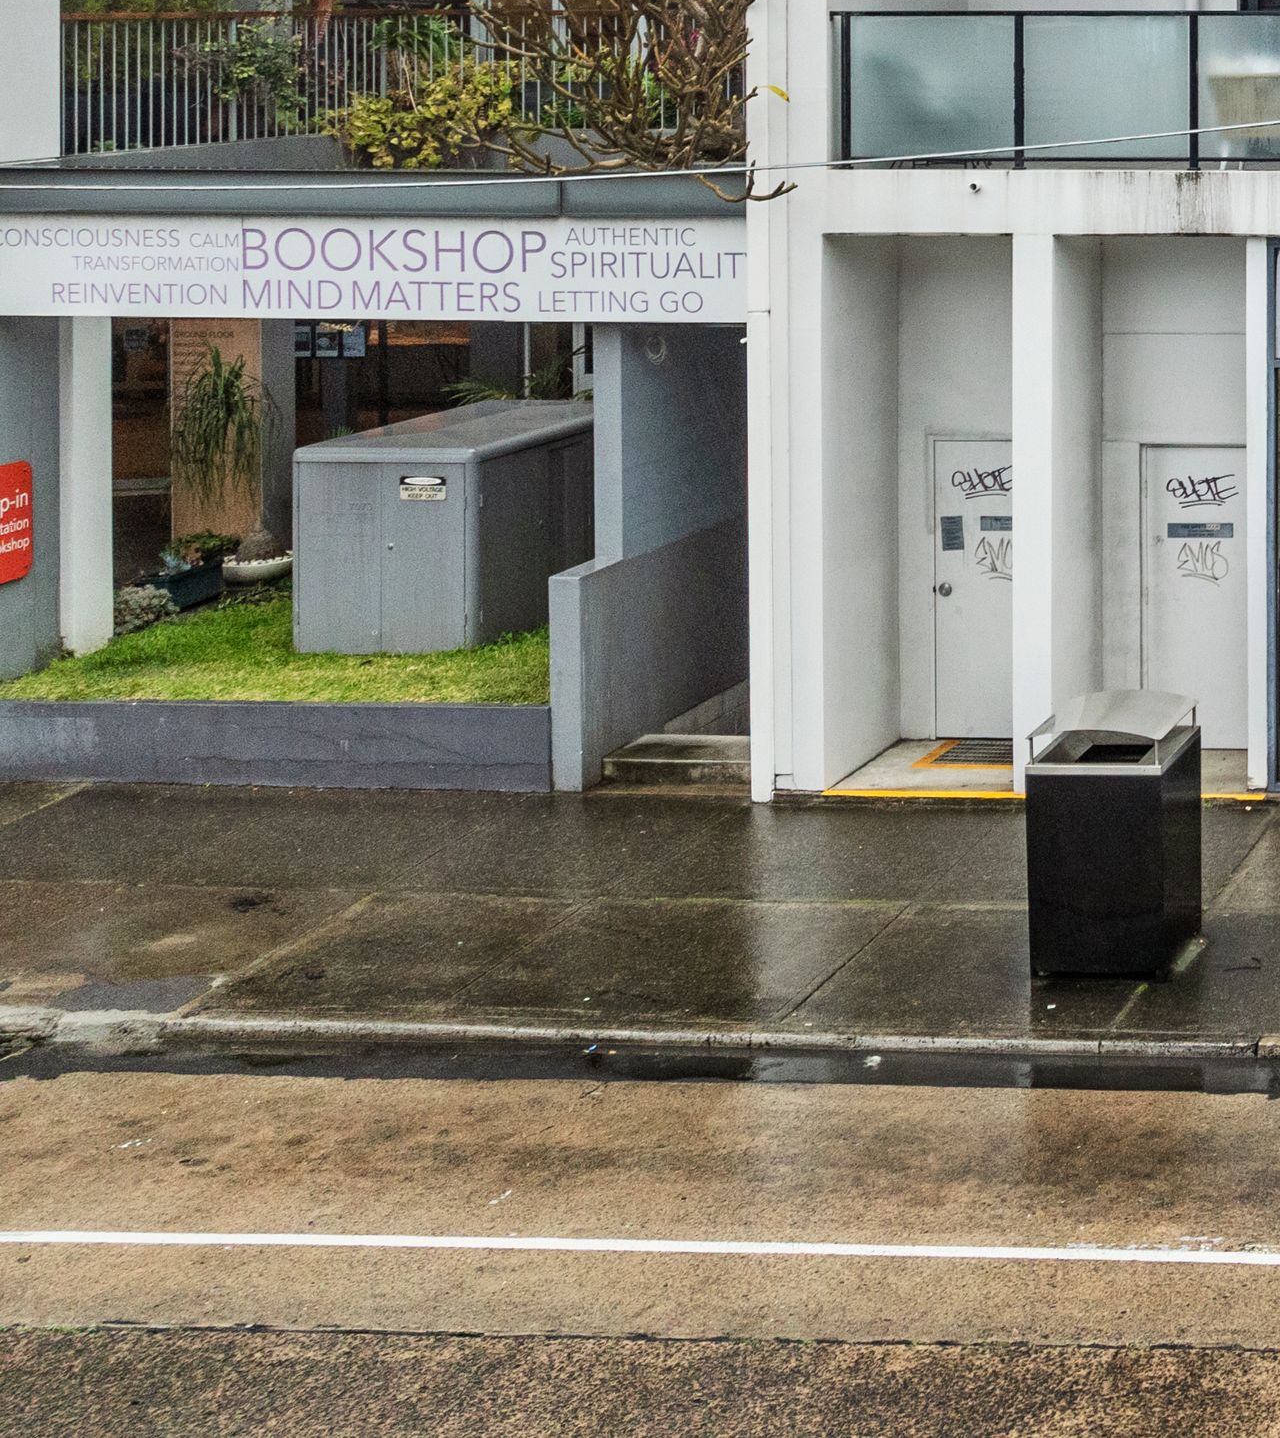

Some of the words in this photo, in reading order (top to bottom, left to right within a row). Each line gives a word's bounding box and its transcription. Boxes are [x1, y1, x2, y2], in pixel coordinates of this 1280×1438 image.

[0, 228, 180, 247] ONSCIOUSNESS
[189, 233, 239, 248] CALM
[565, 227, 696, 246] AUTHENTIC
[242, 227, 547, 273] BOOKSHOP
[72, 255, 239, 272] TRANSFORMATION
[550, 251, 746, 279] SPIRITUALIT
[52, 283, 227, 305] REINVENTION
[242, 279, 342, 310] MIND
[352, 280, 521, 313] MATTERS
[538, 290, 649, 313] LETTING
[659, 290, 704, 313] GO
